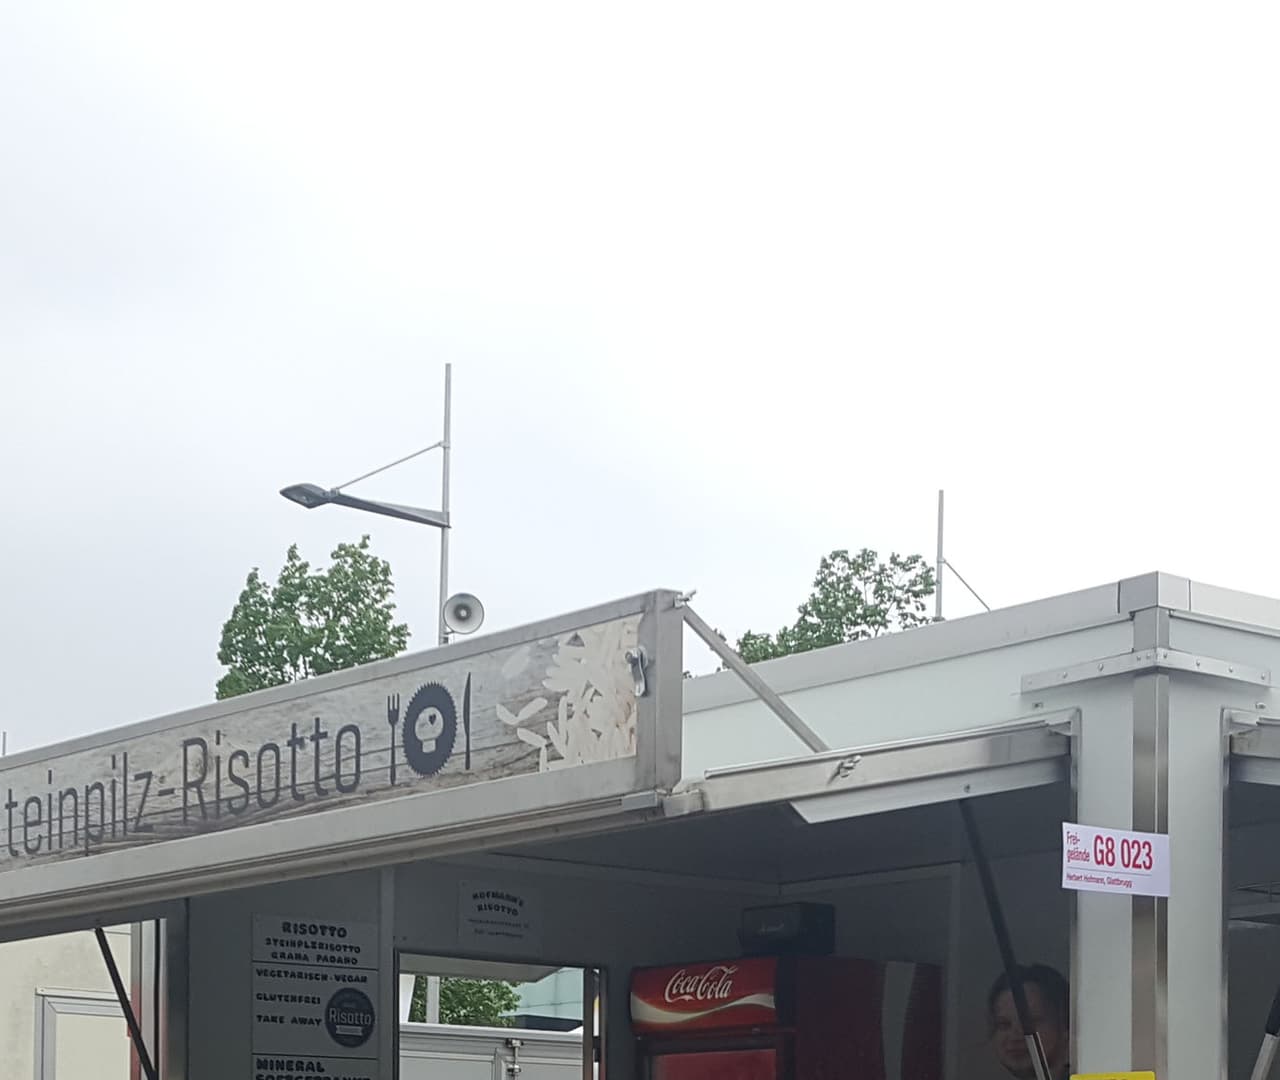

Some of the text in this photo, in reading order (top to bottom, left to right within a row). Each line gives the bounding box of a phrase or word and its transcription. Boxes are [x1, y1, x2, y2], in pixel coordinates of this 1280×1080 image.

[1094, 834, 1153, 870] G8 023
[282, 921, 347, 938] RISOTTO
[665, 965, 738, 1003] Coca-Cola
[256, 1014, 322, 1027] TAKE AWAY
[329, 1007, 372, 1025] Risotto
[256, 1058, 325, 1072] MINERAL
